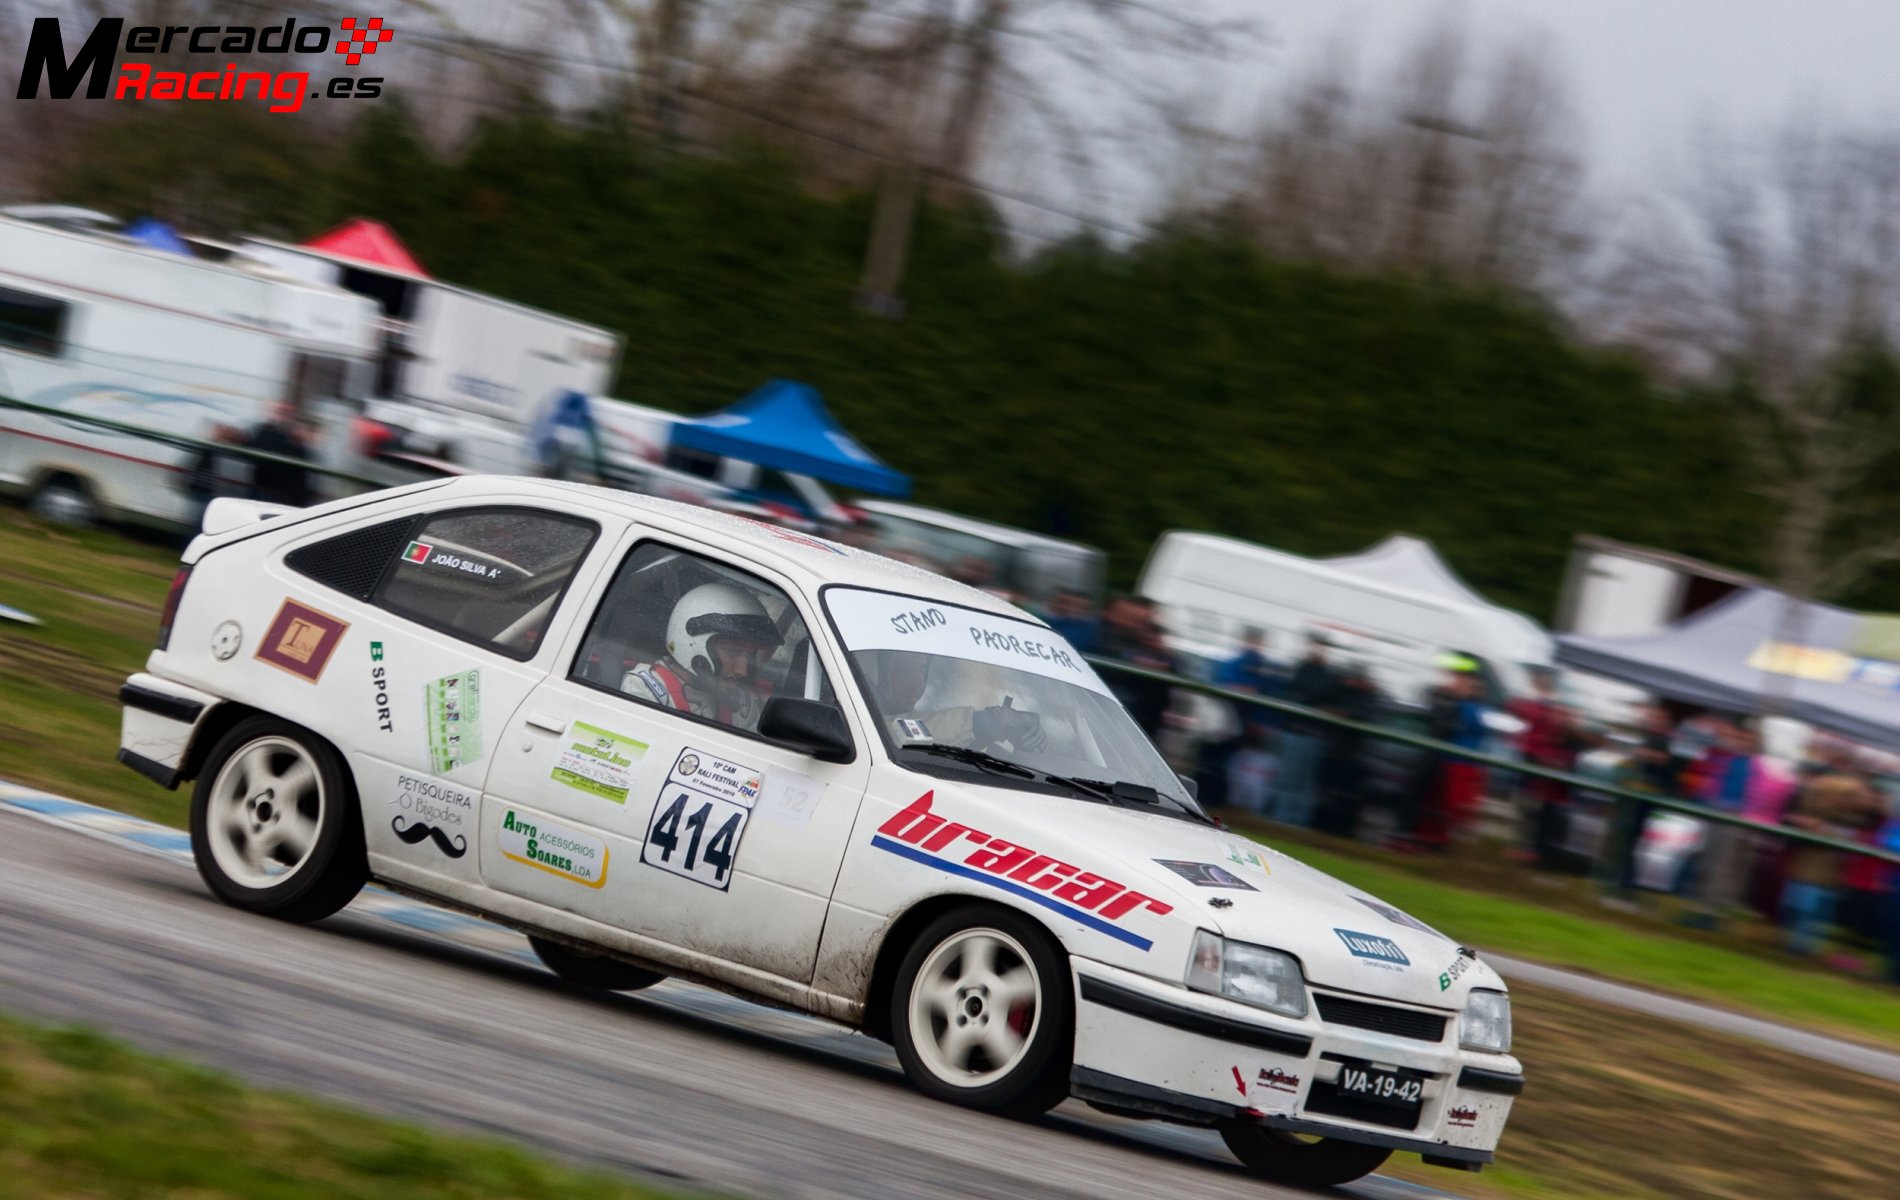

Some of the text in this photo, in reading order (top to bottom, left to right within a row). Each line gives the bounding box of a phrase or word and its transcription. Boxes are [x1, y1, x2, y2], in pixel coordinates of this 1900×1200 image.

[432, 554, 460, 569] JOÃO
[460, 561, 486, 576] SILVA
[891, 608, 947, 635] STAND
[370, 641, 393, 733] B SPORT
[697, 768, 740, 789] RALI FESTIVAL
[723, 765, 737, 775] CAM
[397, 775, 472, 810] PETISQUEIRA
[503, 810, 596, 859] AUTO ACESSÓRIOS
[650, 793, 743, 882] 414
[876, 789, 1174, 921] bracar
[1439, 972, 1451, 992] B
[1343, 1069, 1421, 1103] VA-19-42
